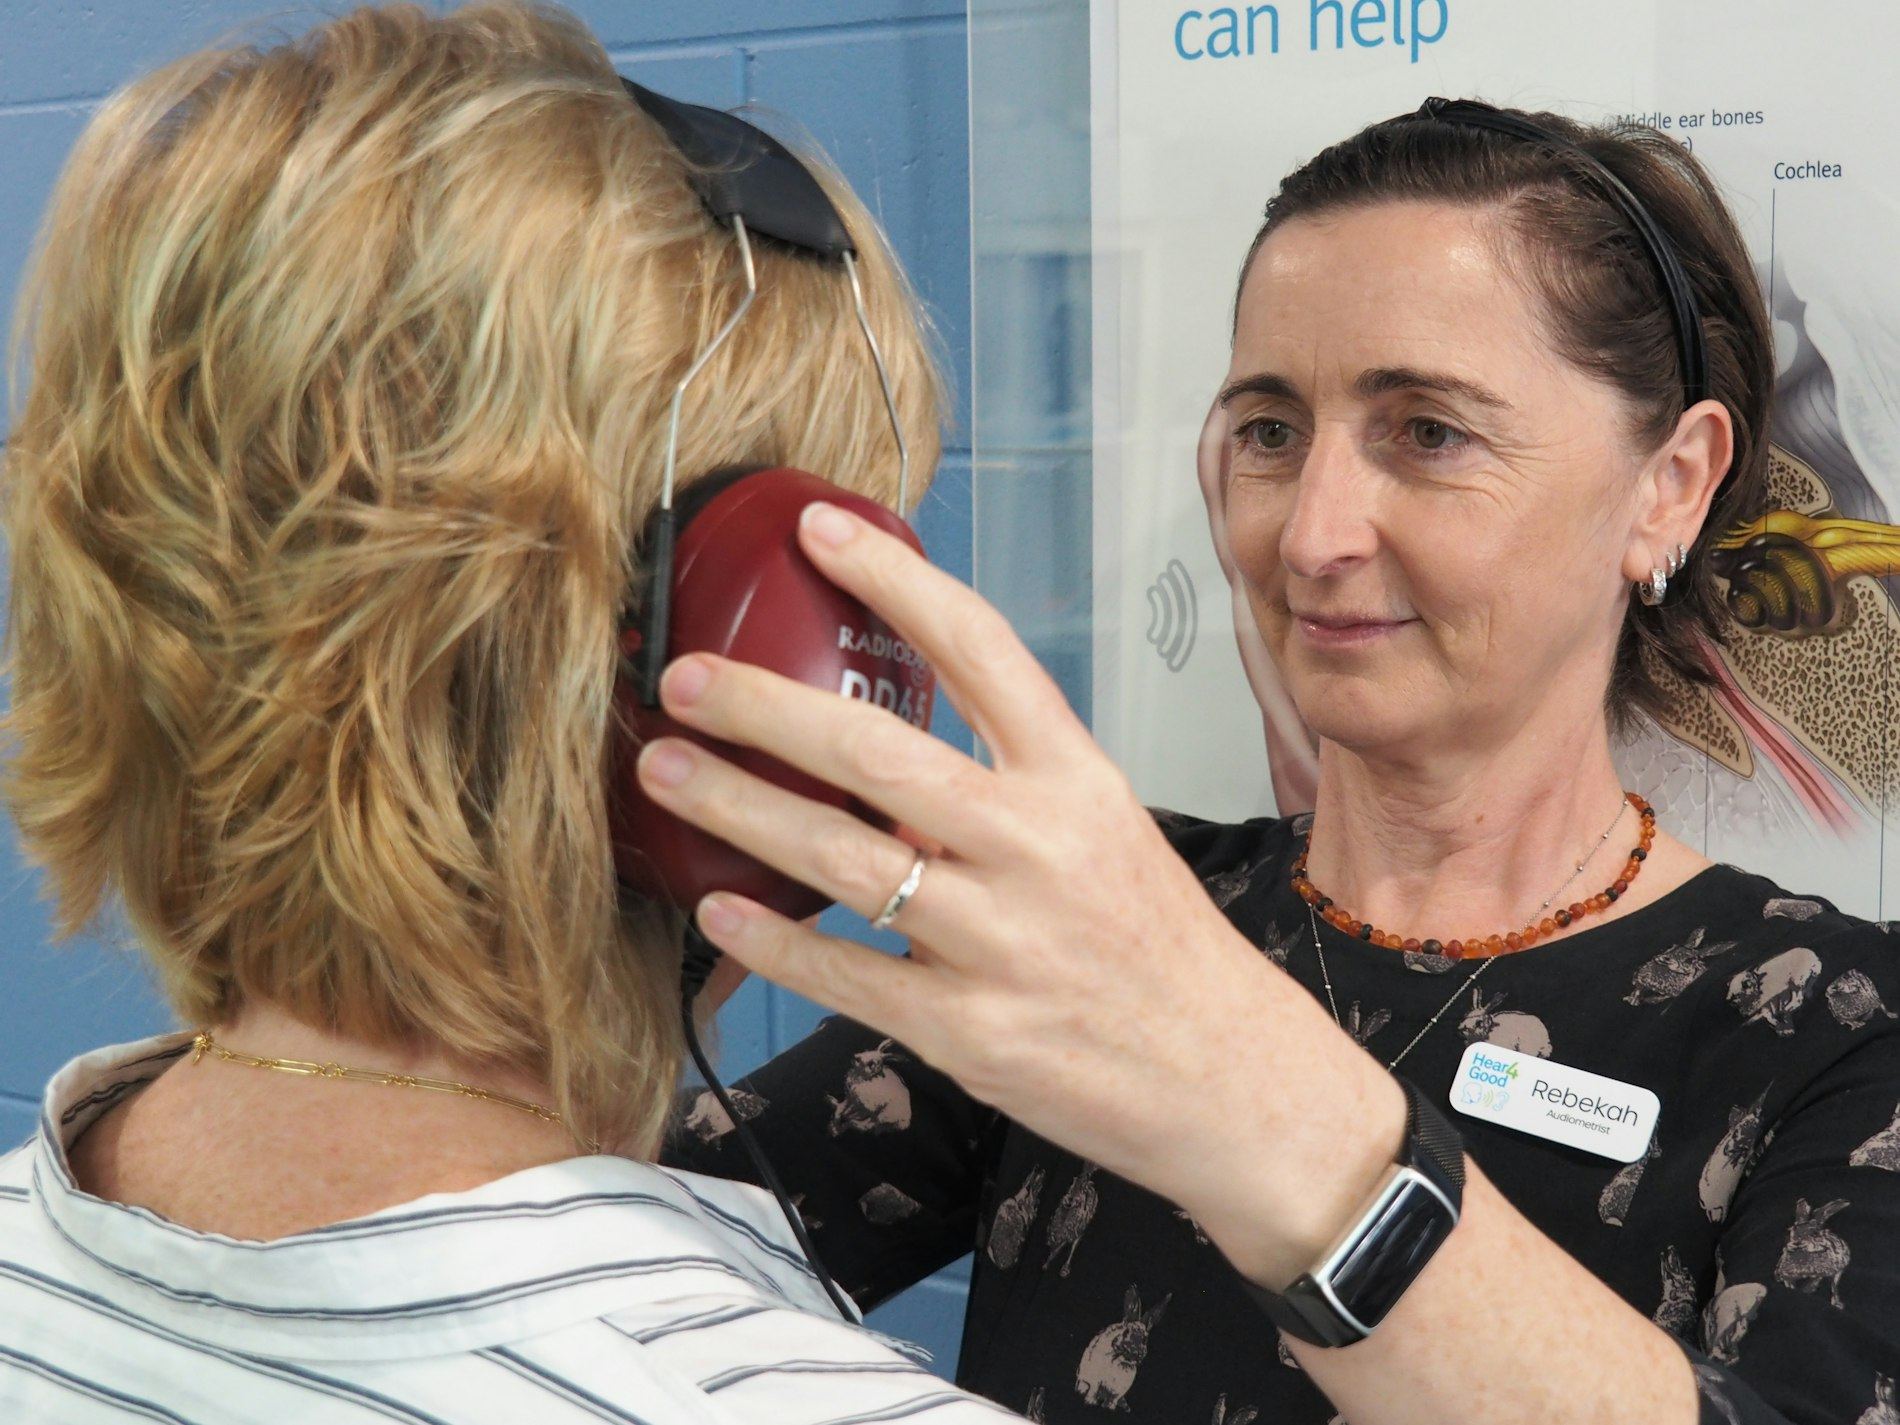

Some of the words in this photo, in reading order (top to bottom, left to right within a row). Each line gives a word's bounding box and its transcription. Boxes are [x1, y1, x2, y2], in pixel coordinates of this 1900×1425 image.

[1174, 4, 1279, 60] can
[1310, 0, 1448, 64] help
[1616, 112, 1672, 131] Middle
[1678, 113, 1704, 129] ear
[1712, 109, 1764, 127] bones
[1774, 160, 1842, 180] Cochlea
[1469, 1065, 1509, 1088] Good
[1531, 1079, 1639, 1127] Rebekah
[1545, 1109, 1611, 1135] Audiometrist
